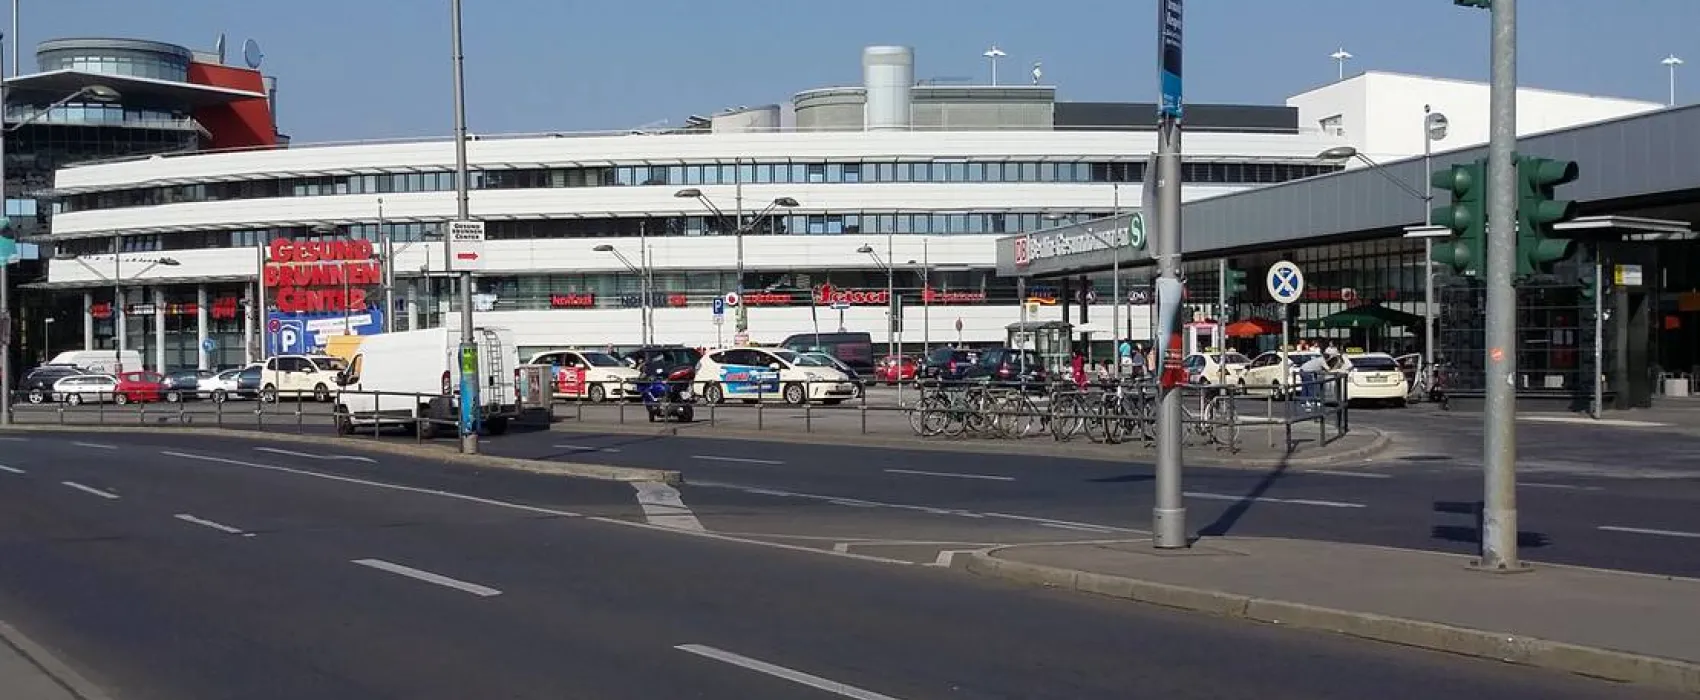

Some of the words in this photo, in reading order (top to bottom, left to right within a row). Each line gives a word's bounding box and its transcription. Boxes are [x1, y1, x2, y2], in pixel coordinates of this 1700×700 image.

[270, 238, 373, 263] GESUND
[1015, 234, 1029, 263] DB
[264, 263, 382, 287] BRUNNEN
[277, 287, 367, 312] CENTER
[714, 299, 722, 313] P
[281, 332, 297, 353] P
